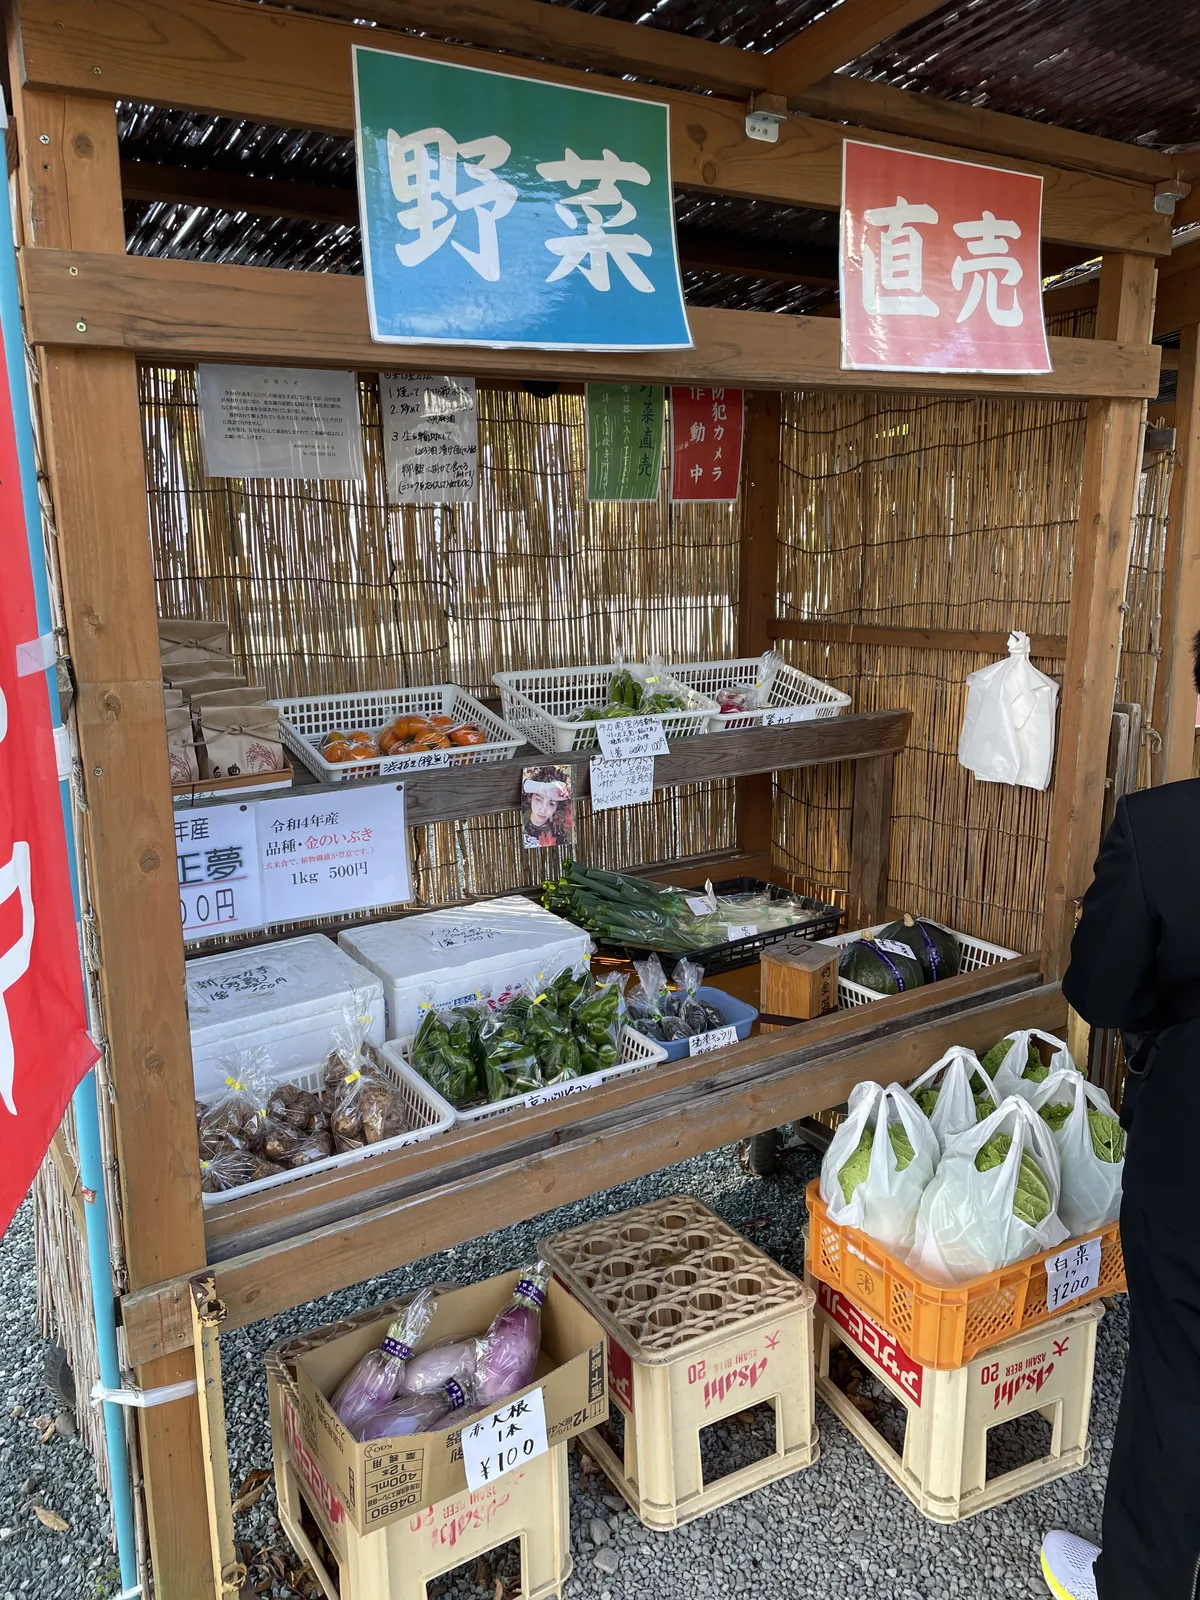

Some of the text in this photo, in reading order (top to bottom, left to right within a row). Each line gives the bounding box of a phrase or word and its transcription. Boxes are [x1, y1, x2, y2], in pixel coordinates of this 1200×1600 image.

[387, 127, 655, 293] 野菜
[862, 196, 1024, 327] 直売
[690, 387, 706, 485] 作動中
[711, 387, 727, 482] 防犯カメラ
[270, 811, 339, 833] 令和4年産
[177, 846, 243, 885] 正夢
[291, 861, 368, 885] 1kg 500円
[1054, 1244, 1089, 1272] 白菜
[1052, 1275, 1089, 1305] ¥200
[821, 1285, 919, 1399] アサヒビール
[1052, 1336, 1070, 1357] 大
[687, 1360, 707, 1385] 20
[981, 1362, 999, 1386] 20
[1005, 1352, 1047, 1377] ASAHI BEER
[703, 1357, 768, 1410] Asahi
[993, 1362, 1054, 1411] Asahi
[498, 1423, 523, 1442] 1本
[381, 1464, 406, 1477] 12本
[480, 1438, 534, 1480] ¥100
[370, 1472, 417, 1493] 400mL
[371, 1494, 416, 1519] 04690
